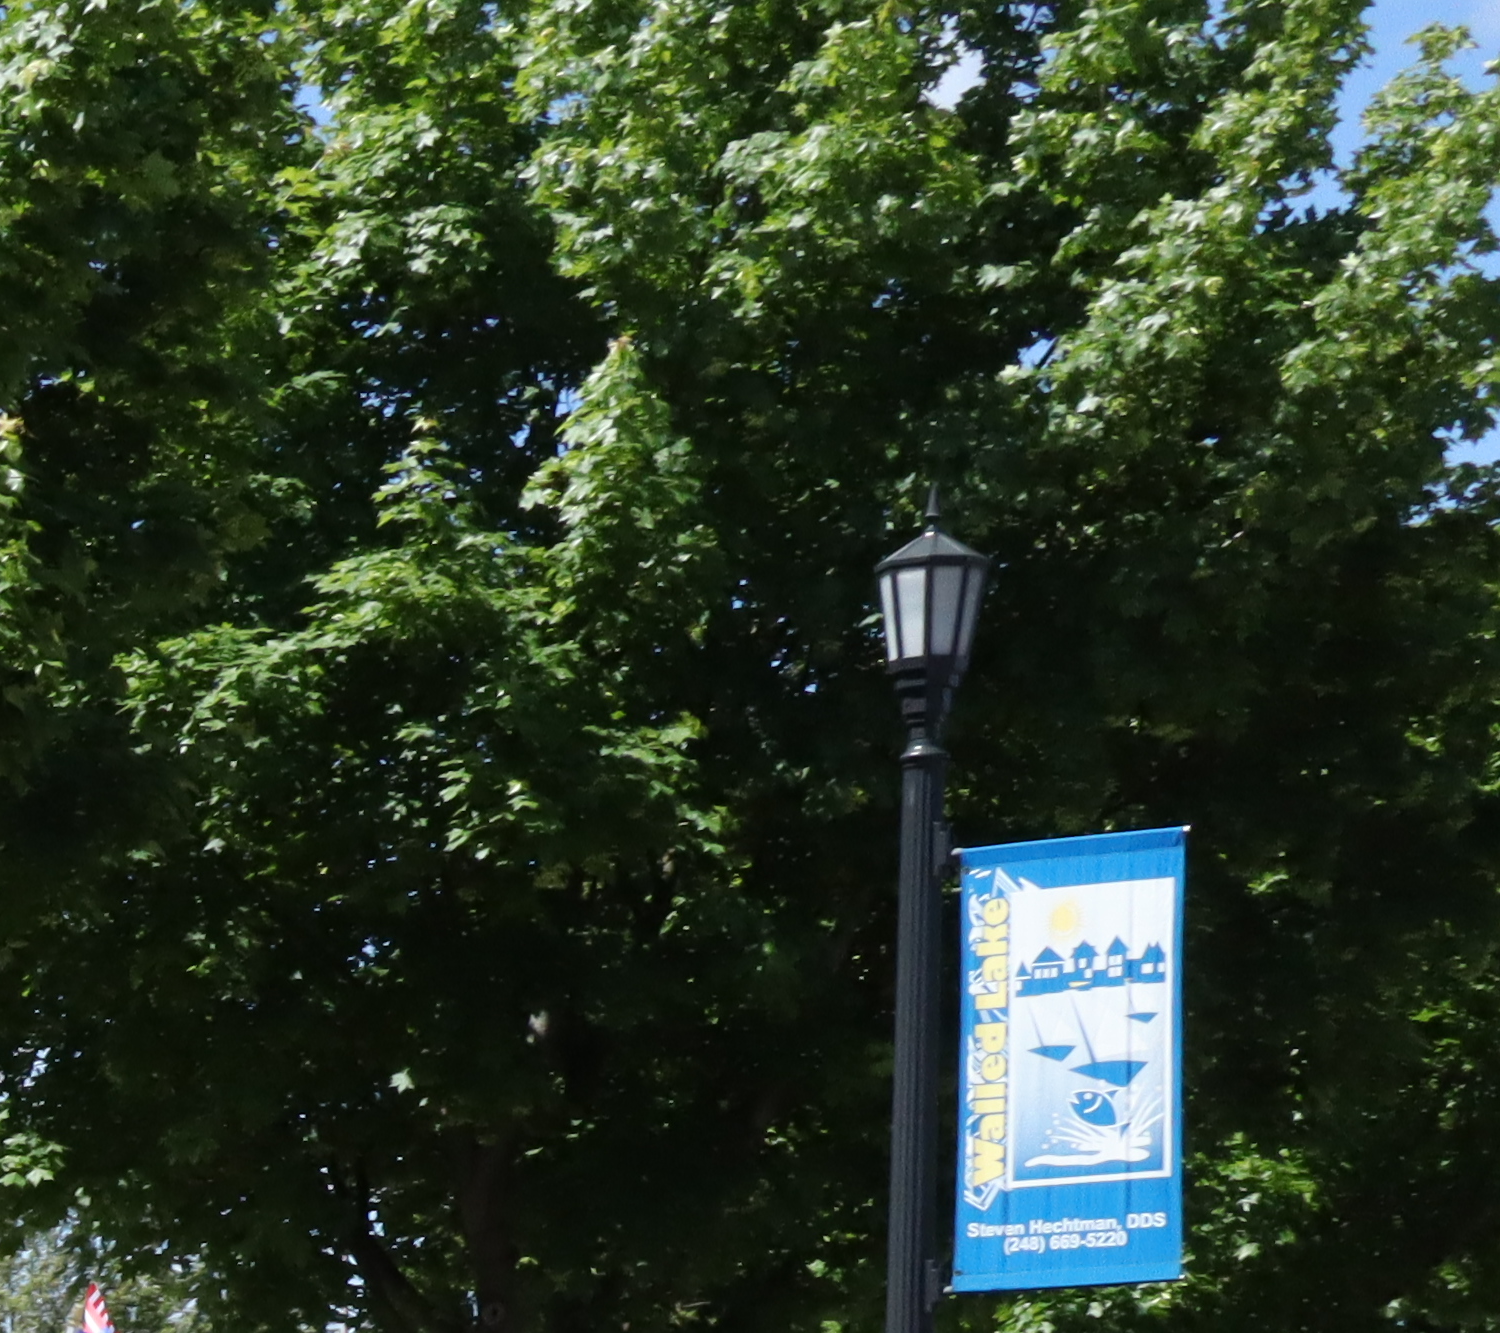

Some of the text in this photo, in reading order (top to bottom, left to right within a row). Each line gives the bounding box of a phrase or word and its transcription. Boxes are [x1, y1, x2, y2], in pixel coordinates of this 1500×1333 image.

[972, 897, 1010, 1186] Walled Lake
[967, 1212, 1168, 1238] Steven Hechtman, DDS
[1004, 1230, 1128, 1255] (248) 669-5220
